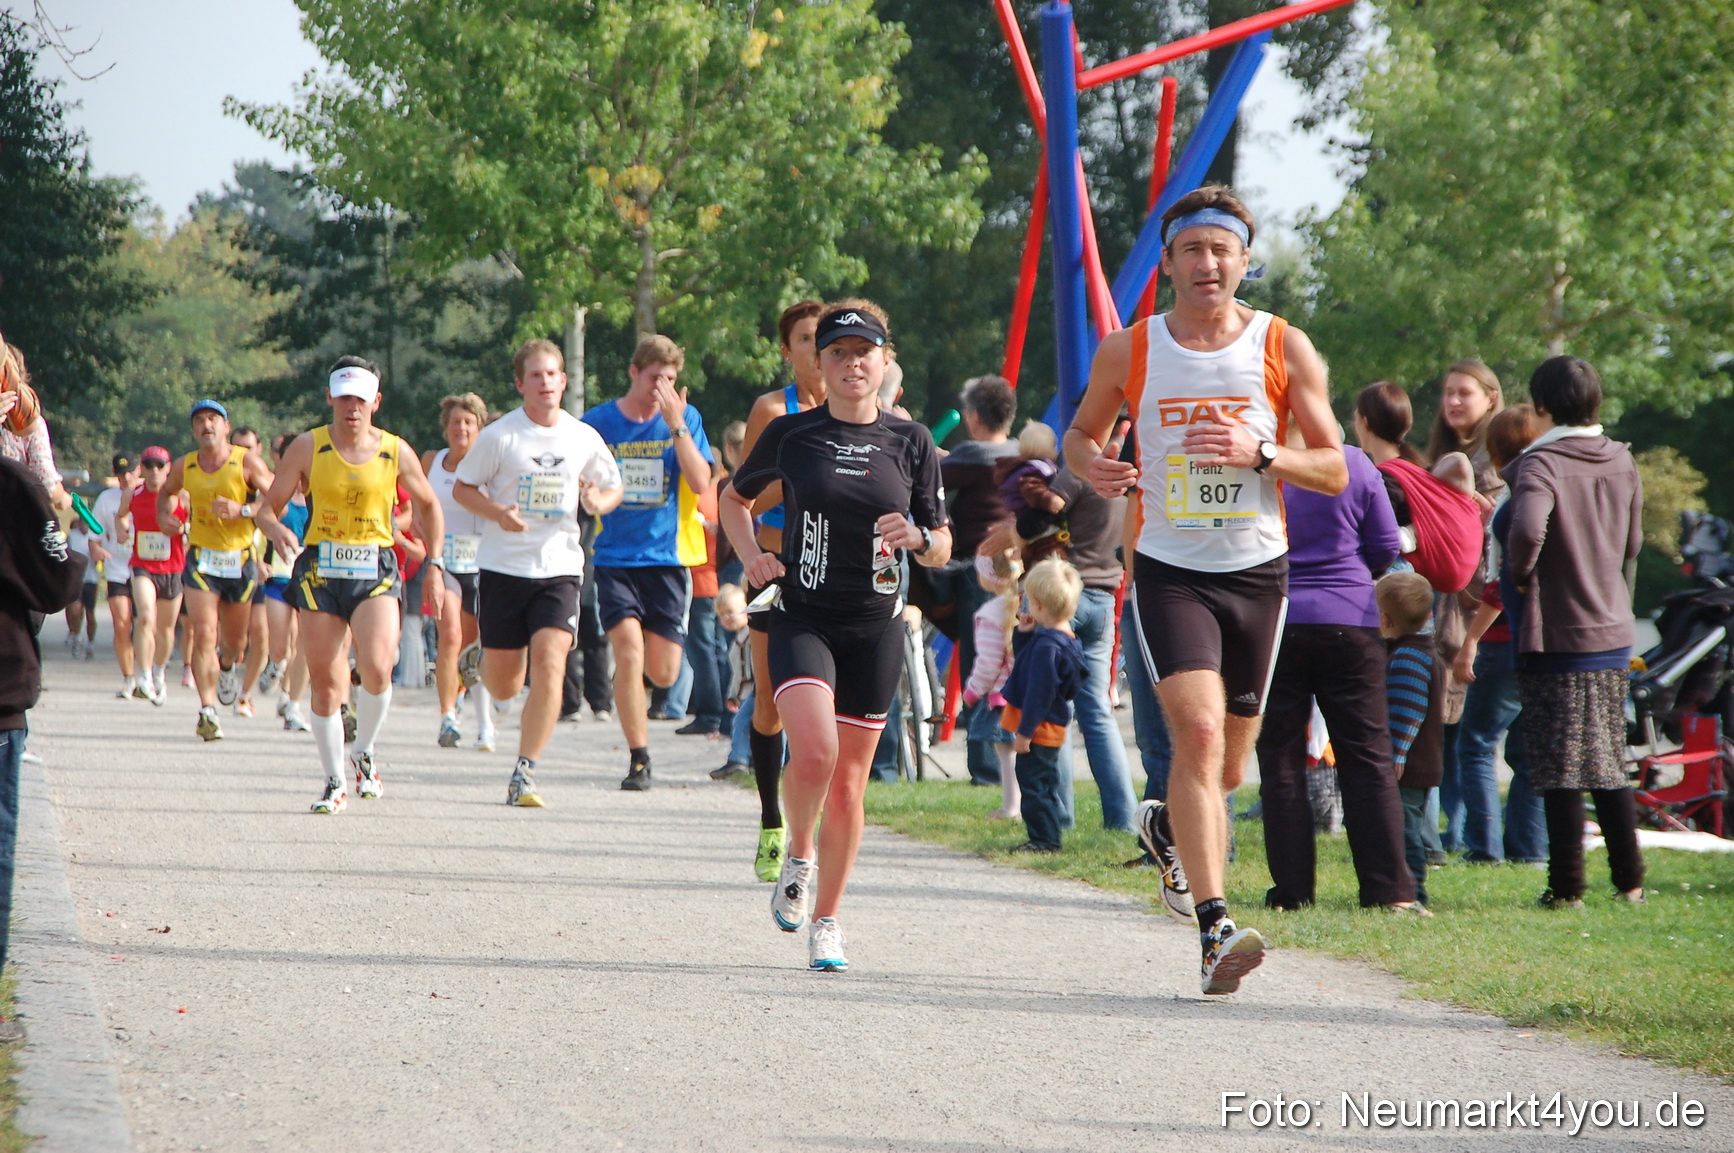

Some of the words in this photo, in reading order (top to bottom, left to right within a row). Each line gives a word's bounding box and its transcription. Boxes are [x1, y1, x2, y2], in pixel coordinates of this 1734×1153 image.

[1158, 397, 1251, 427] DAK
[1189, 461, 1223, 475] Franz
[626, 474, 657, 487] 3485
[1171, 484, 1177, 494] A
[1199, 483, 1244, 504] 807
[533, 492, 565, 505] 2687
[335, 547, 371, 561] 6022
